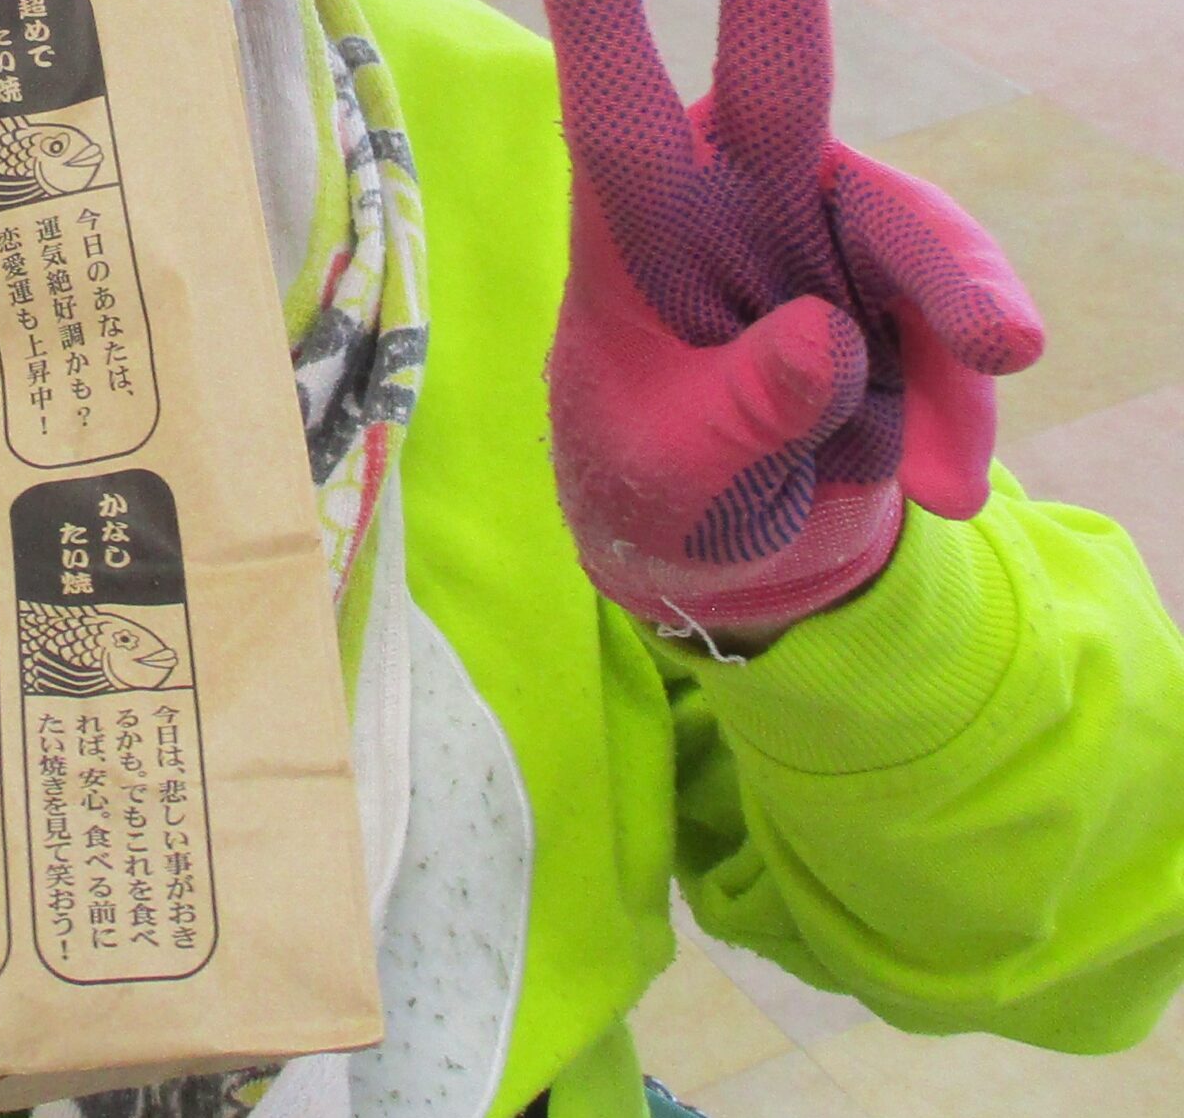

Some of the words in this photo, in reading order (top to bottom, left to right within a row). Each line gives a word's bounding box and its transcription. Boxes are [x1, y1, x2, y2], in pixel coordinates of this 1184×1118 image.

[35, 215, 92, 428] 運気絶好調かも？
[76, 207, 135, 396] 今日のあなたは、
[58, 522, 93, 595] たい焼
[98, 491, 131, 568] かなし
[37, 713, 76, 961] たい焼きを見て笑おう！
[75, 714, 119, 950] れば、安心。食べる前に
[115, 708, 161, 949] るかも。でもこれを食べ
[152, 704, 198, 951] 今日は、悲しい事がおき
